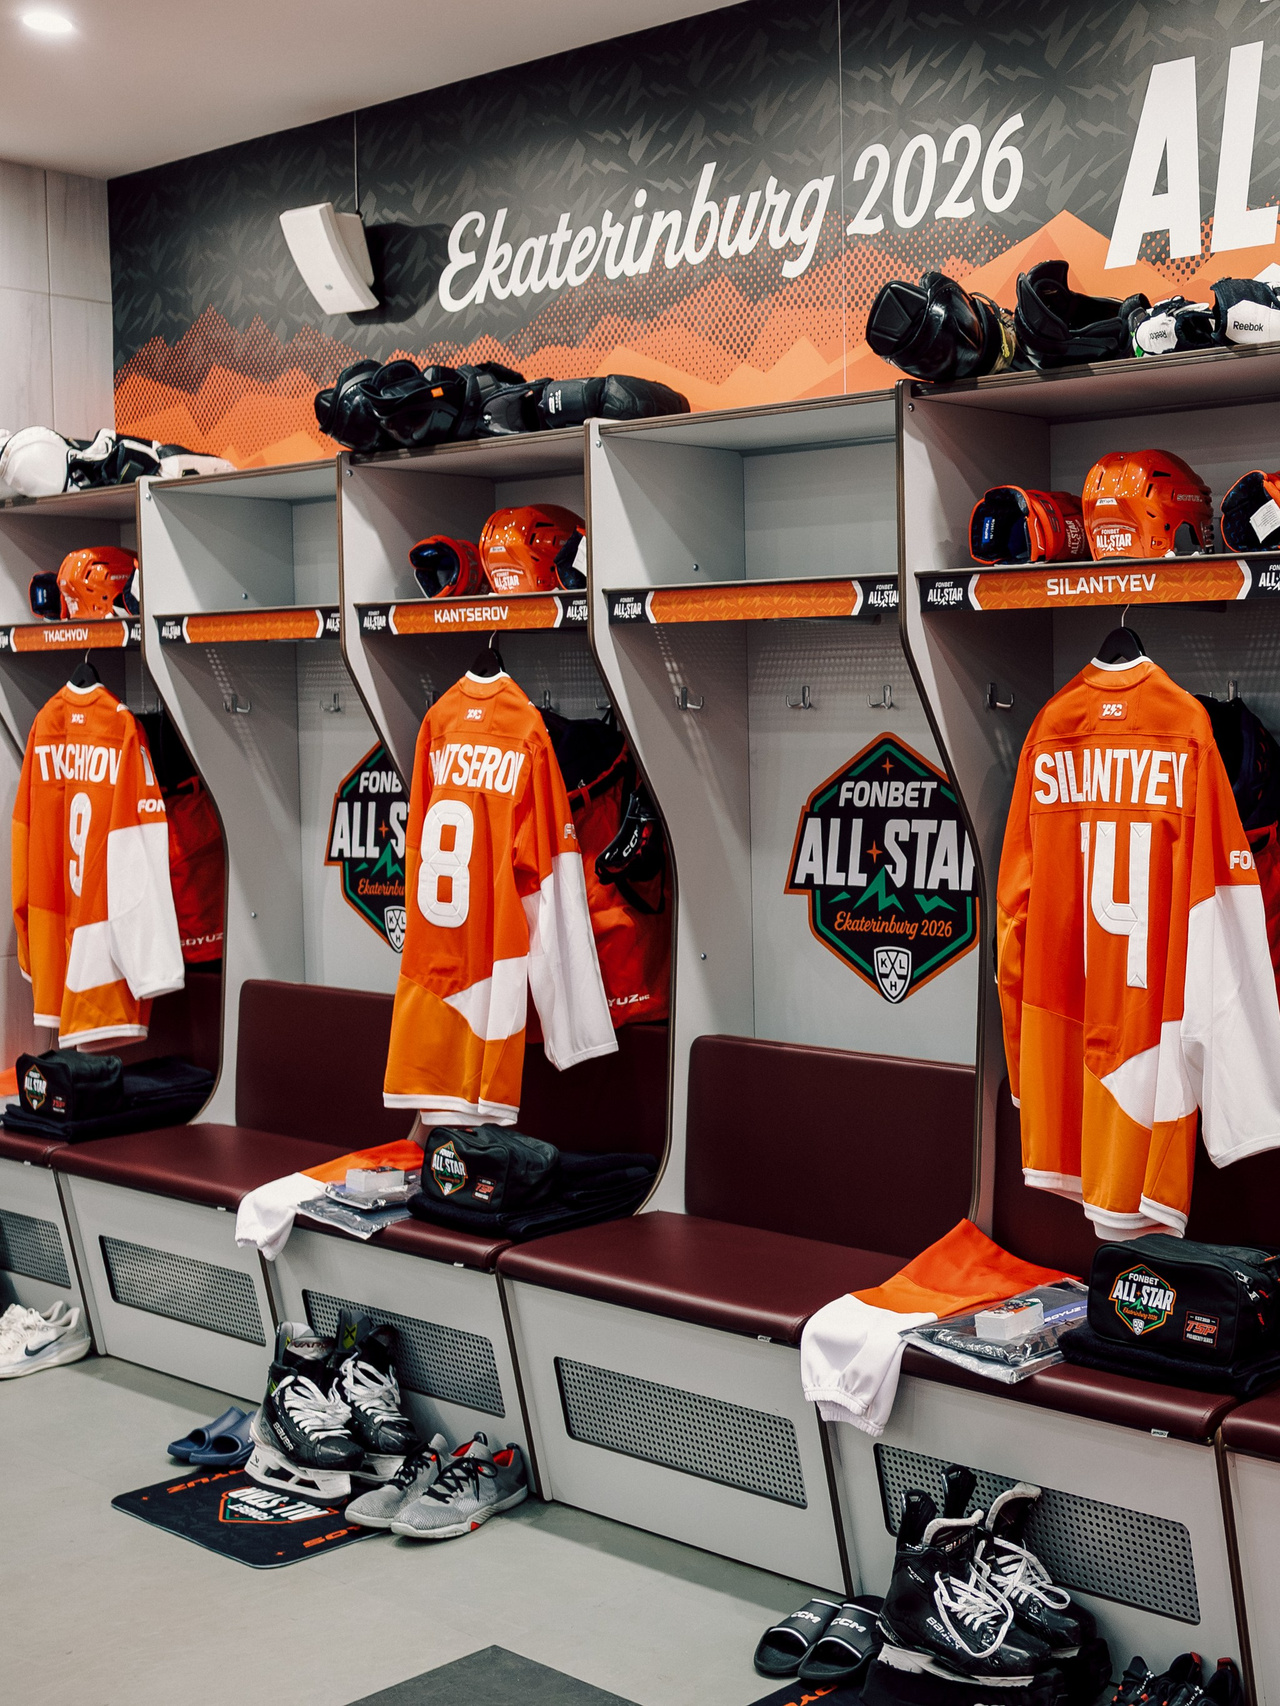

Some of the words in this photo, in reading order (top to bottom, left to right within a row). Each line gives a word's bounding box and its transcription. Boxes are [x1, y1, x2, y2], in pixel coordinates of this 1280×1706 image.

[438, 160, 835, 313] Ekaterinburg
[845, 112, 1025, 237] 2026
[1232, 320, 1264, 332] Reebok
[1096, 534, 1108, 548] ALL
[1109, 533, 1132, 547] STAR
[1046, 573, 1157, 596] SILANTYEV
[1258, 572, 1276, 587] ALL
[868, 591, 881, 605] ALL
[927, 588, 942, 602] ALL
[943, 587, 963, 601] STAR
[434, 606, 509, 624] KANTSEROV
[579, 605, 588, 617] ST
[613, 604, 625, 616] ALL
[626, 603, 642, 615] STAR
[43, 628, 89, 643] TKACHYOV
[34, 743, 123, 785] TKCHYOV
[358, 771, 403, 794] FONB
[838, 781, 938, 808] FONBET
[137, 798, 166, 814] FON
[330, 801, 380, 859] ALL
[69, 792, 92, 898] 9
[794, 817, 868, 887] ALL
[417, 799, 475, 928] 8
[357, 878, 405, 896] Ekaterinbu
[834, 911, 920, 940] Ekaterinburg
[920, 919, 953, 938] 2026
[608, 993, 639, 1007] YUZ
[431, 1153, 444, 1172] ALL
[444, 1158, 466, 1176] STAR
[1128, 1272, 1160, 1286] FONBET
[1112, 1279, 1136, 1303] ALL
[1140, 1284, 1175, 1312] STAR
[1185, 1320, 1217, 1336] TSP
[272, 1421, 294, 1452] BAUER
[227, 1486, 290, 1512] STAR
[271, 1500, 330, 1522] ALL
[790, 1610, 822, 1624] CCM
[830, 1617, 867, 1633] CCM
